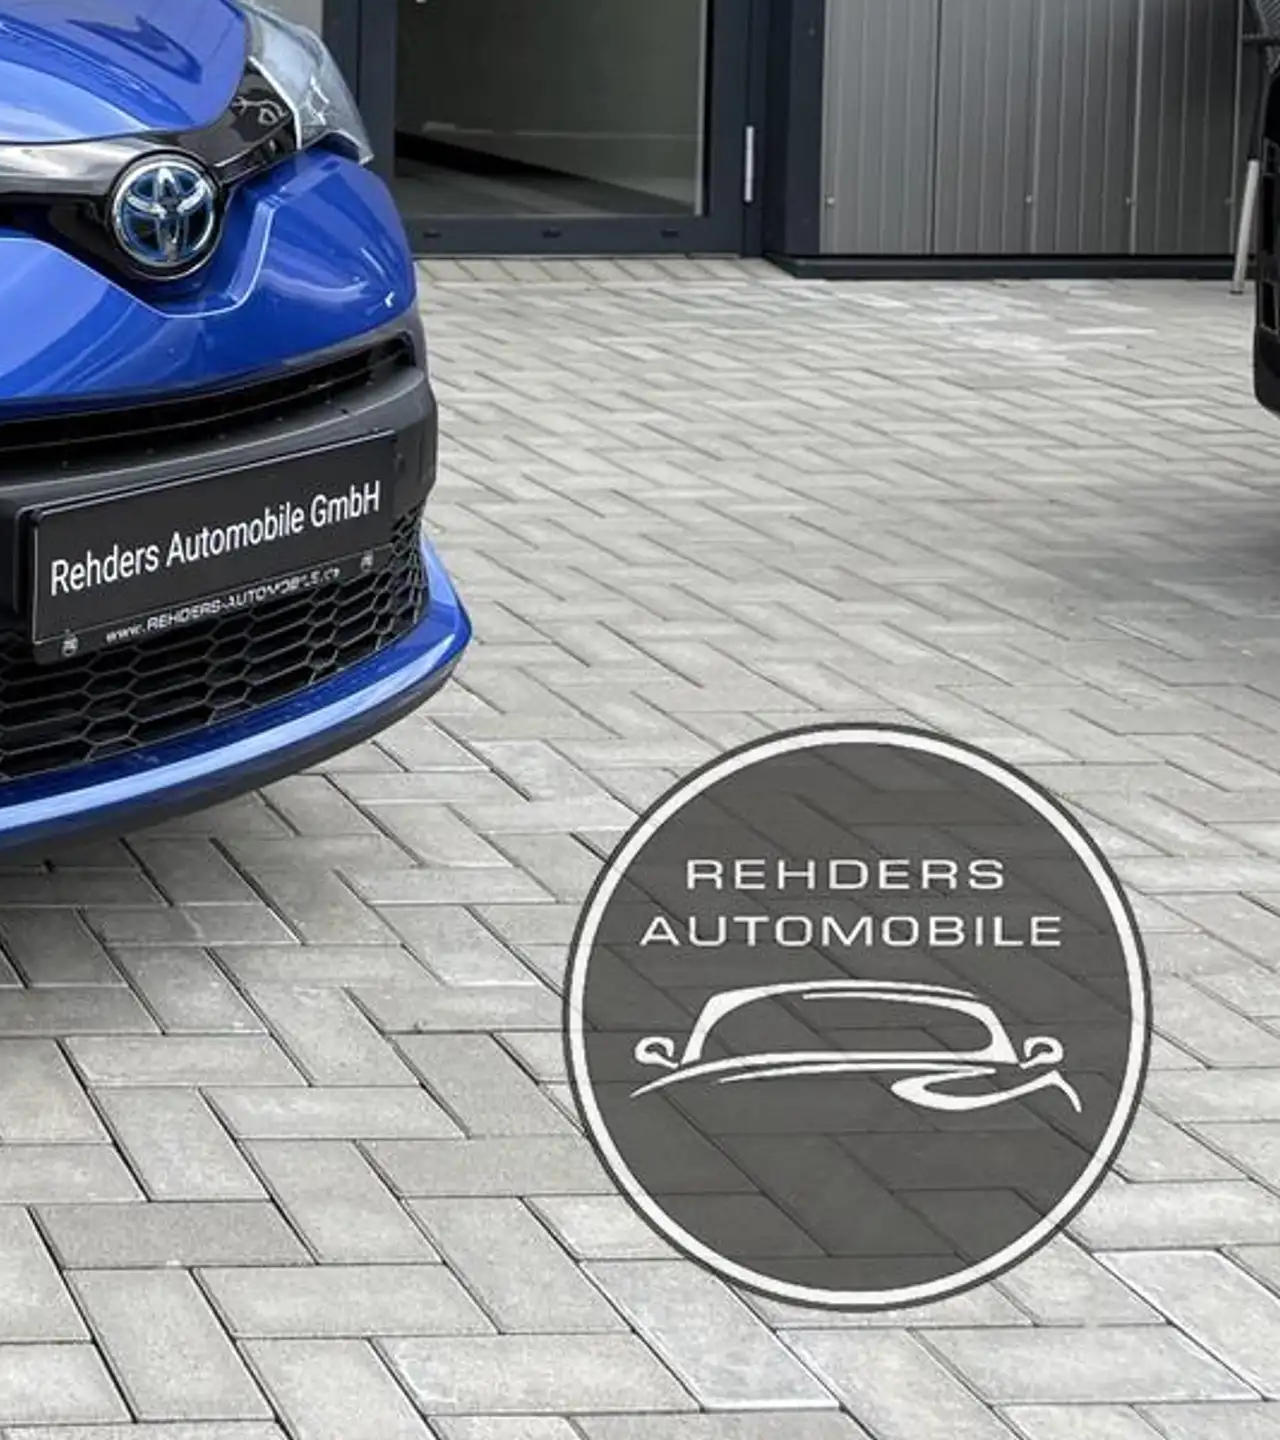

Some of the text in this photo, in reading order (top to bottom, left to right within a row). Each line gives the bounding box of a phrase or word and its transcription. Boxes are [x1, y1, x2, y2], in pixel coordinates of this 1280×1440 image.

[50, 479, 381, 597] Rehders Automobile GmbH
